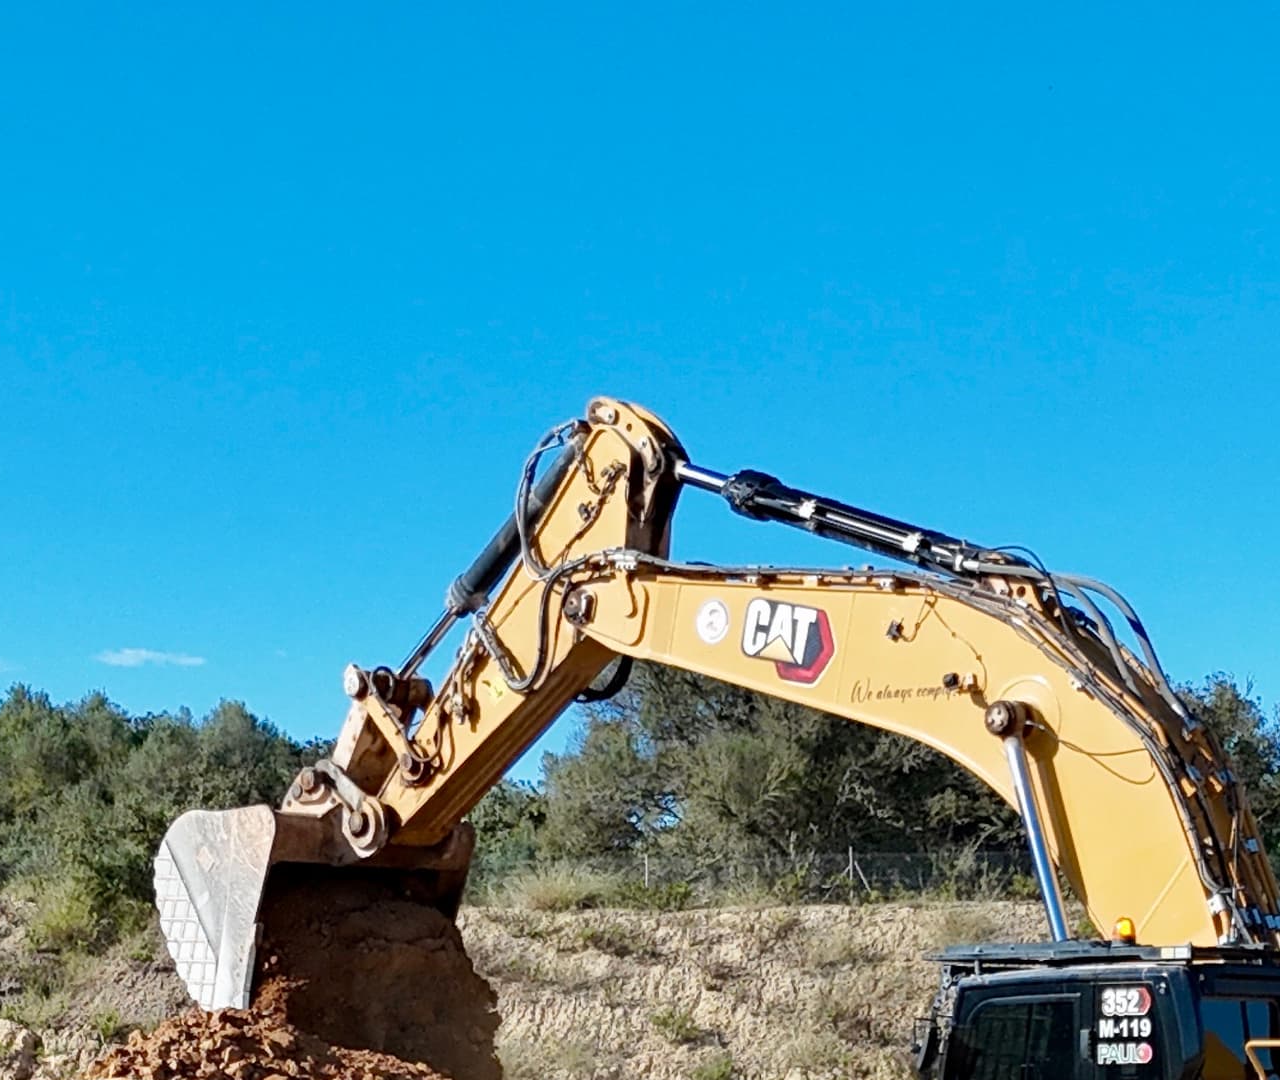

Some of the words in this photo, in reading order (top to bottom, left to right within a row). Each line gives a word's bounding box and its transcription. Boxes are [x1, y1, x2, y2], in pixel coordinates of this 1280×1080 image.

[742, 598, 818, 665] CAT
[850, 677, 873, 703] We
[1102, 987, 1141, 1015] 352
[1099, 1018, 1152, 1038] M-119
[1097, 1042, 1153, 1065] PAULO
